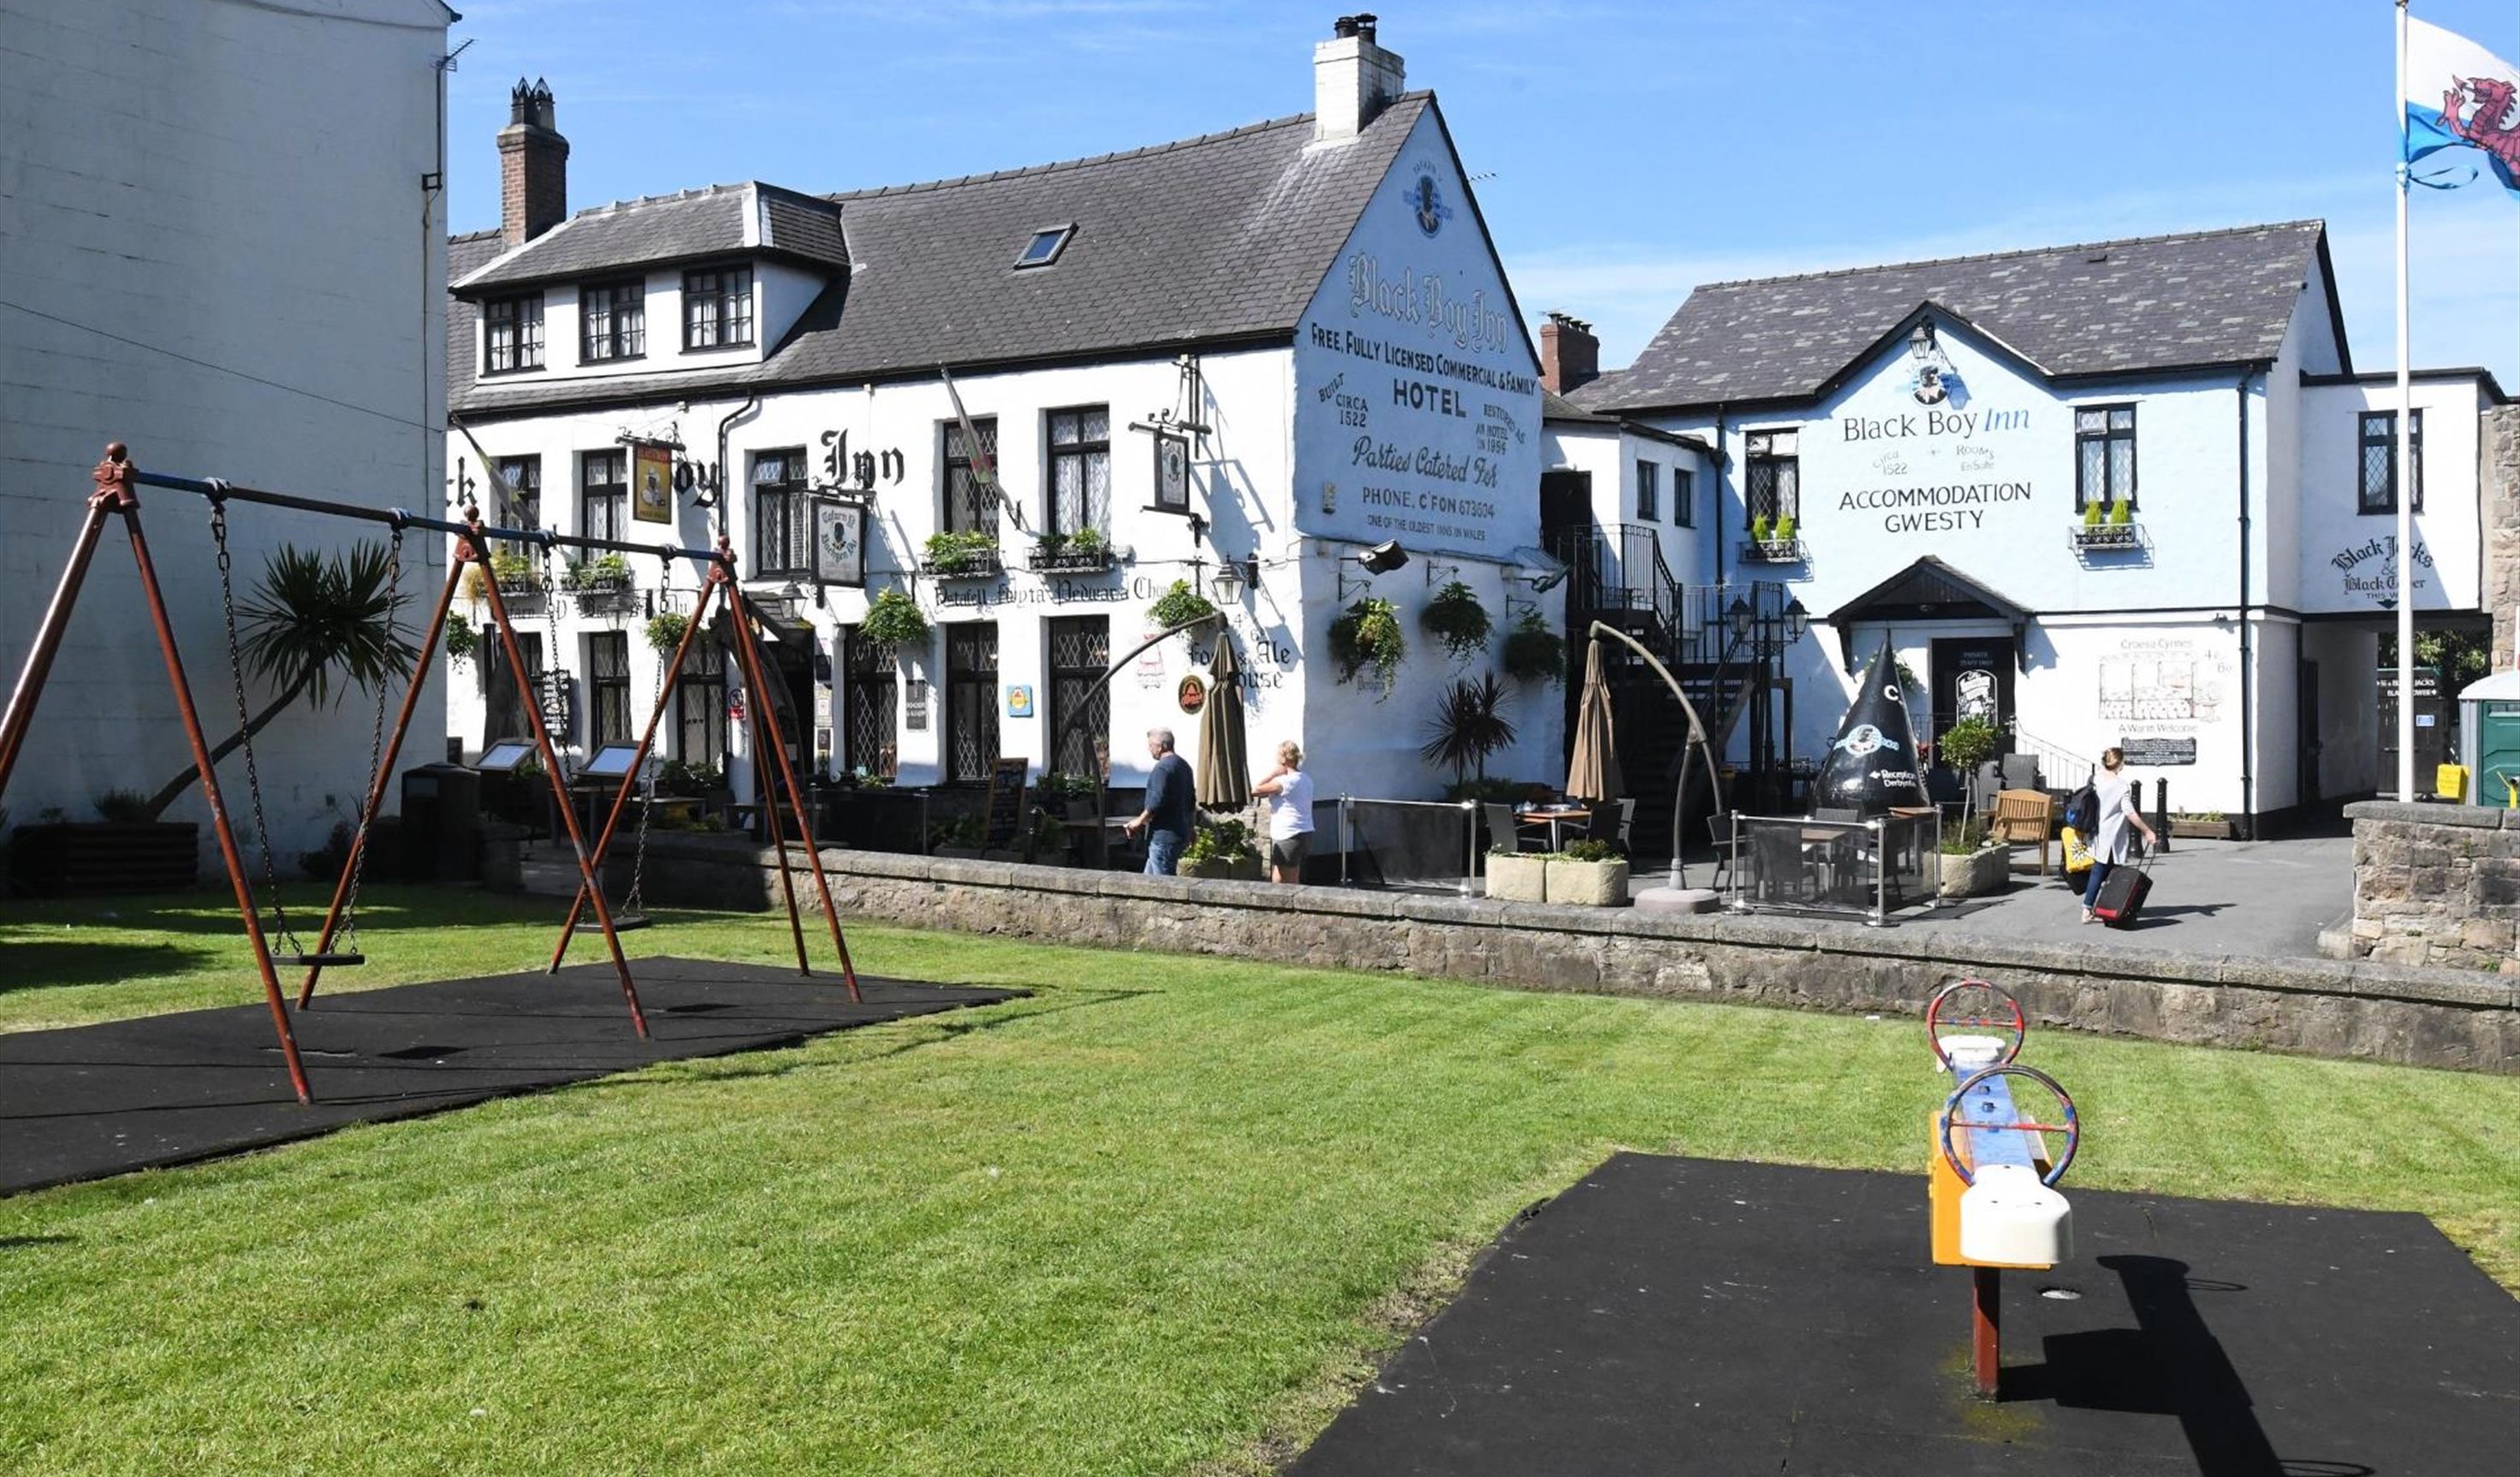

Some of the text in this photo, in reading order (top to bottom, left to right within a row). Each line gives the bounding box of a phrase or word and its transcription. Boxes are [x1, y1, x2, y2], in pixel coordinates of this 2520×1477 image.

[1348, 252, 1508, 354] Black Boy Inn
[1346, 330, 1381, 362] FULLY
[1384, 341, 1434, 374] LICENSED
[1436, 353, 1496, 388] COMMERCIAL
[1506, 371, 1536, 397] FAMILY
[1335, 394, 1369, 412] CIRCA
[1394, 378, 1467, 418] HOTEL
[1340, 409, 1366, 428] 1522
[1843, 407, 2030, 442] Black Boy Inn
[820, 428, 905, 490] Inn
[1351, 435, 1411, 472] Parties
[1415, 446, 1470, 482] Catered
[1882, 461, 1909, 476] 1522
[674, 460, 718, 508] oy
[1838, 481, 2032, 511] ACCOMMODATION
[1884, 509, 1984, 534] GWESTY
[2331, 535, 2434, 578] Black Jks
[2341, 575, 2385, 596] Black
[1257, 638, 1292, 664] Ale
[1236, 670, 1283, 690] ouse
